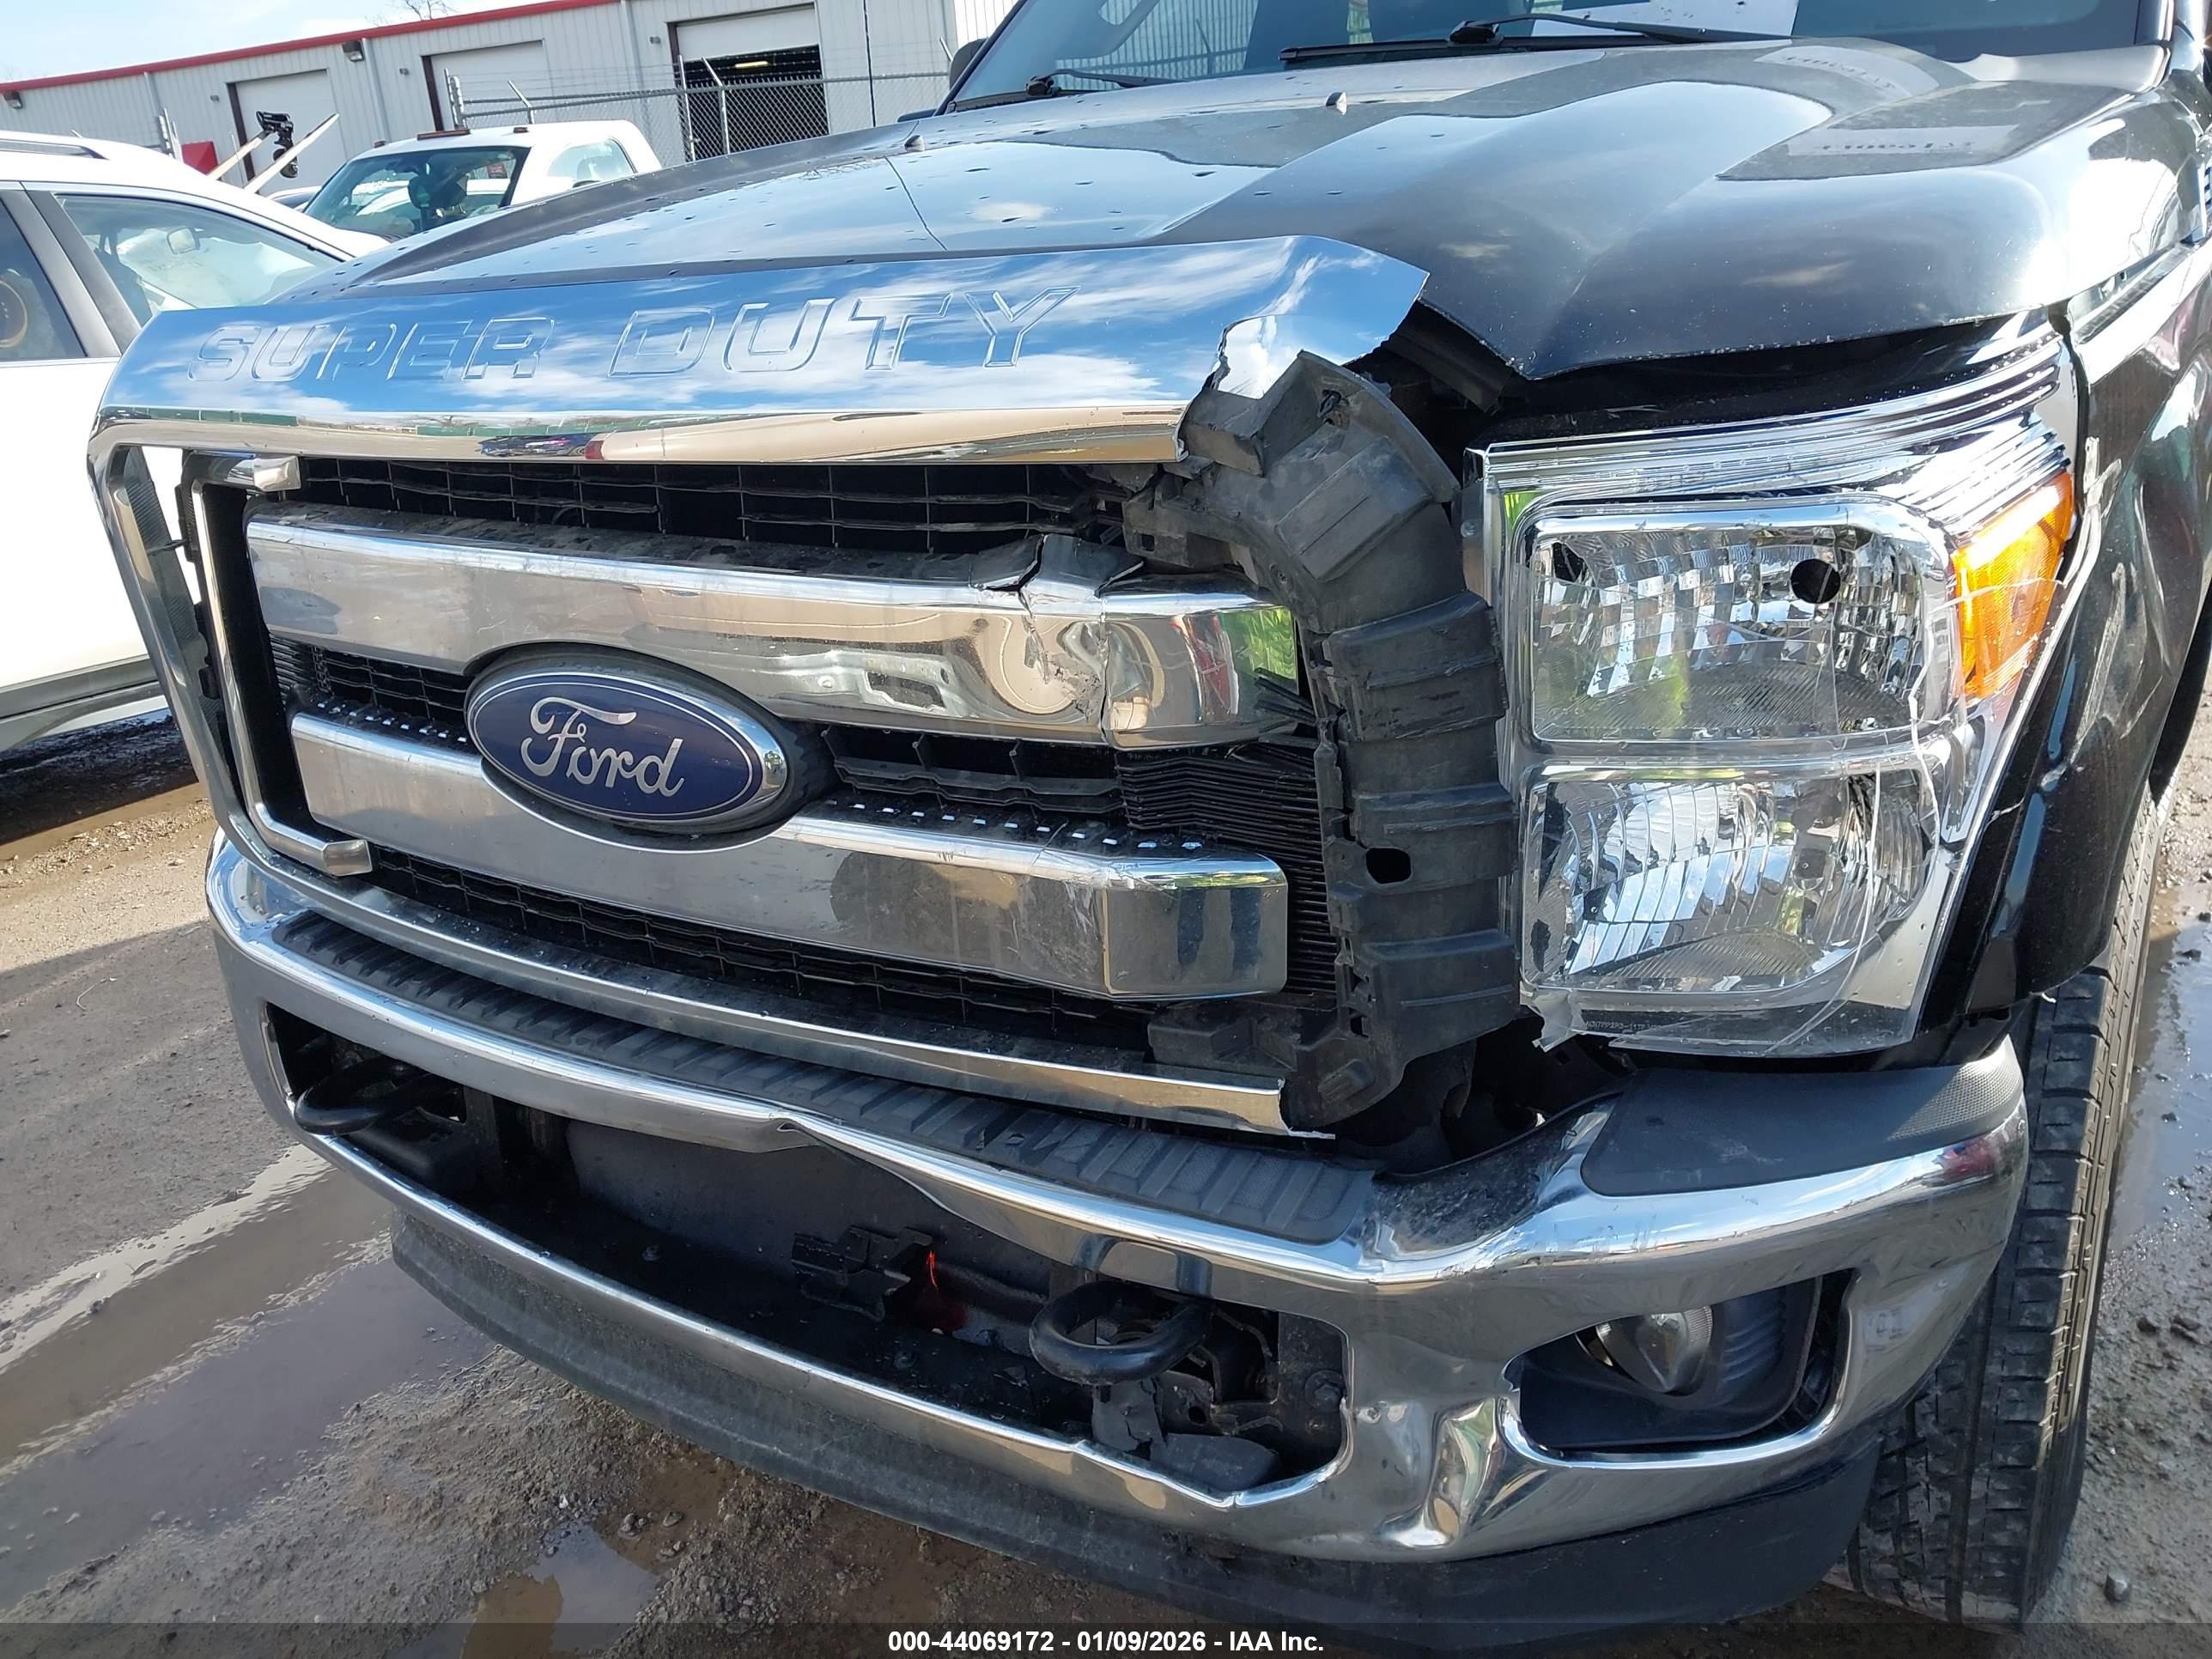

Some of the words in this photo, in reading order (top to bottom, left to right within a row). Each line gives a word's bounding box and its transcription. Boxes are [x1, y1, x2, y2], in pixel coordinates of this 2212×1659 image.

[187, 316, 556, 383] SUPER
[607, 284, 1082, 379] DUTY
[520, 696, 685, 797] Ford
